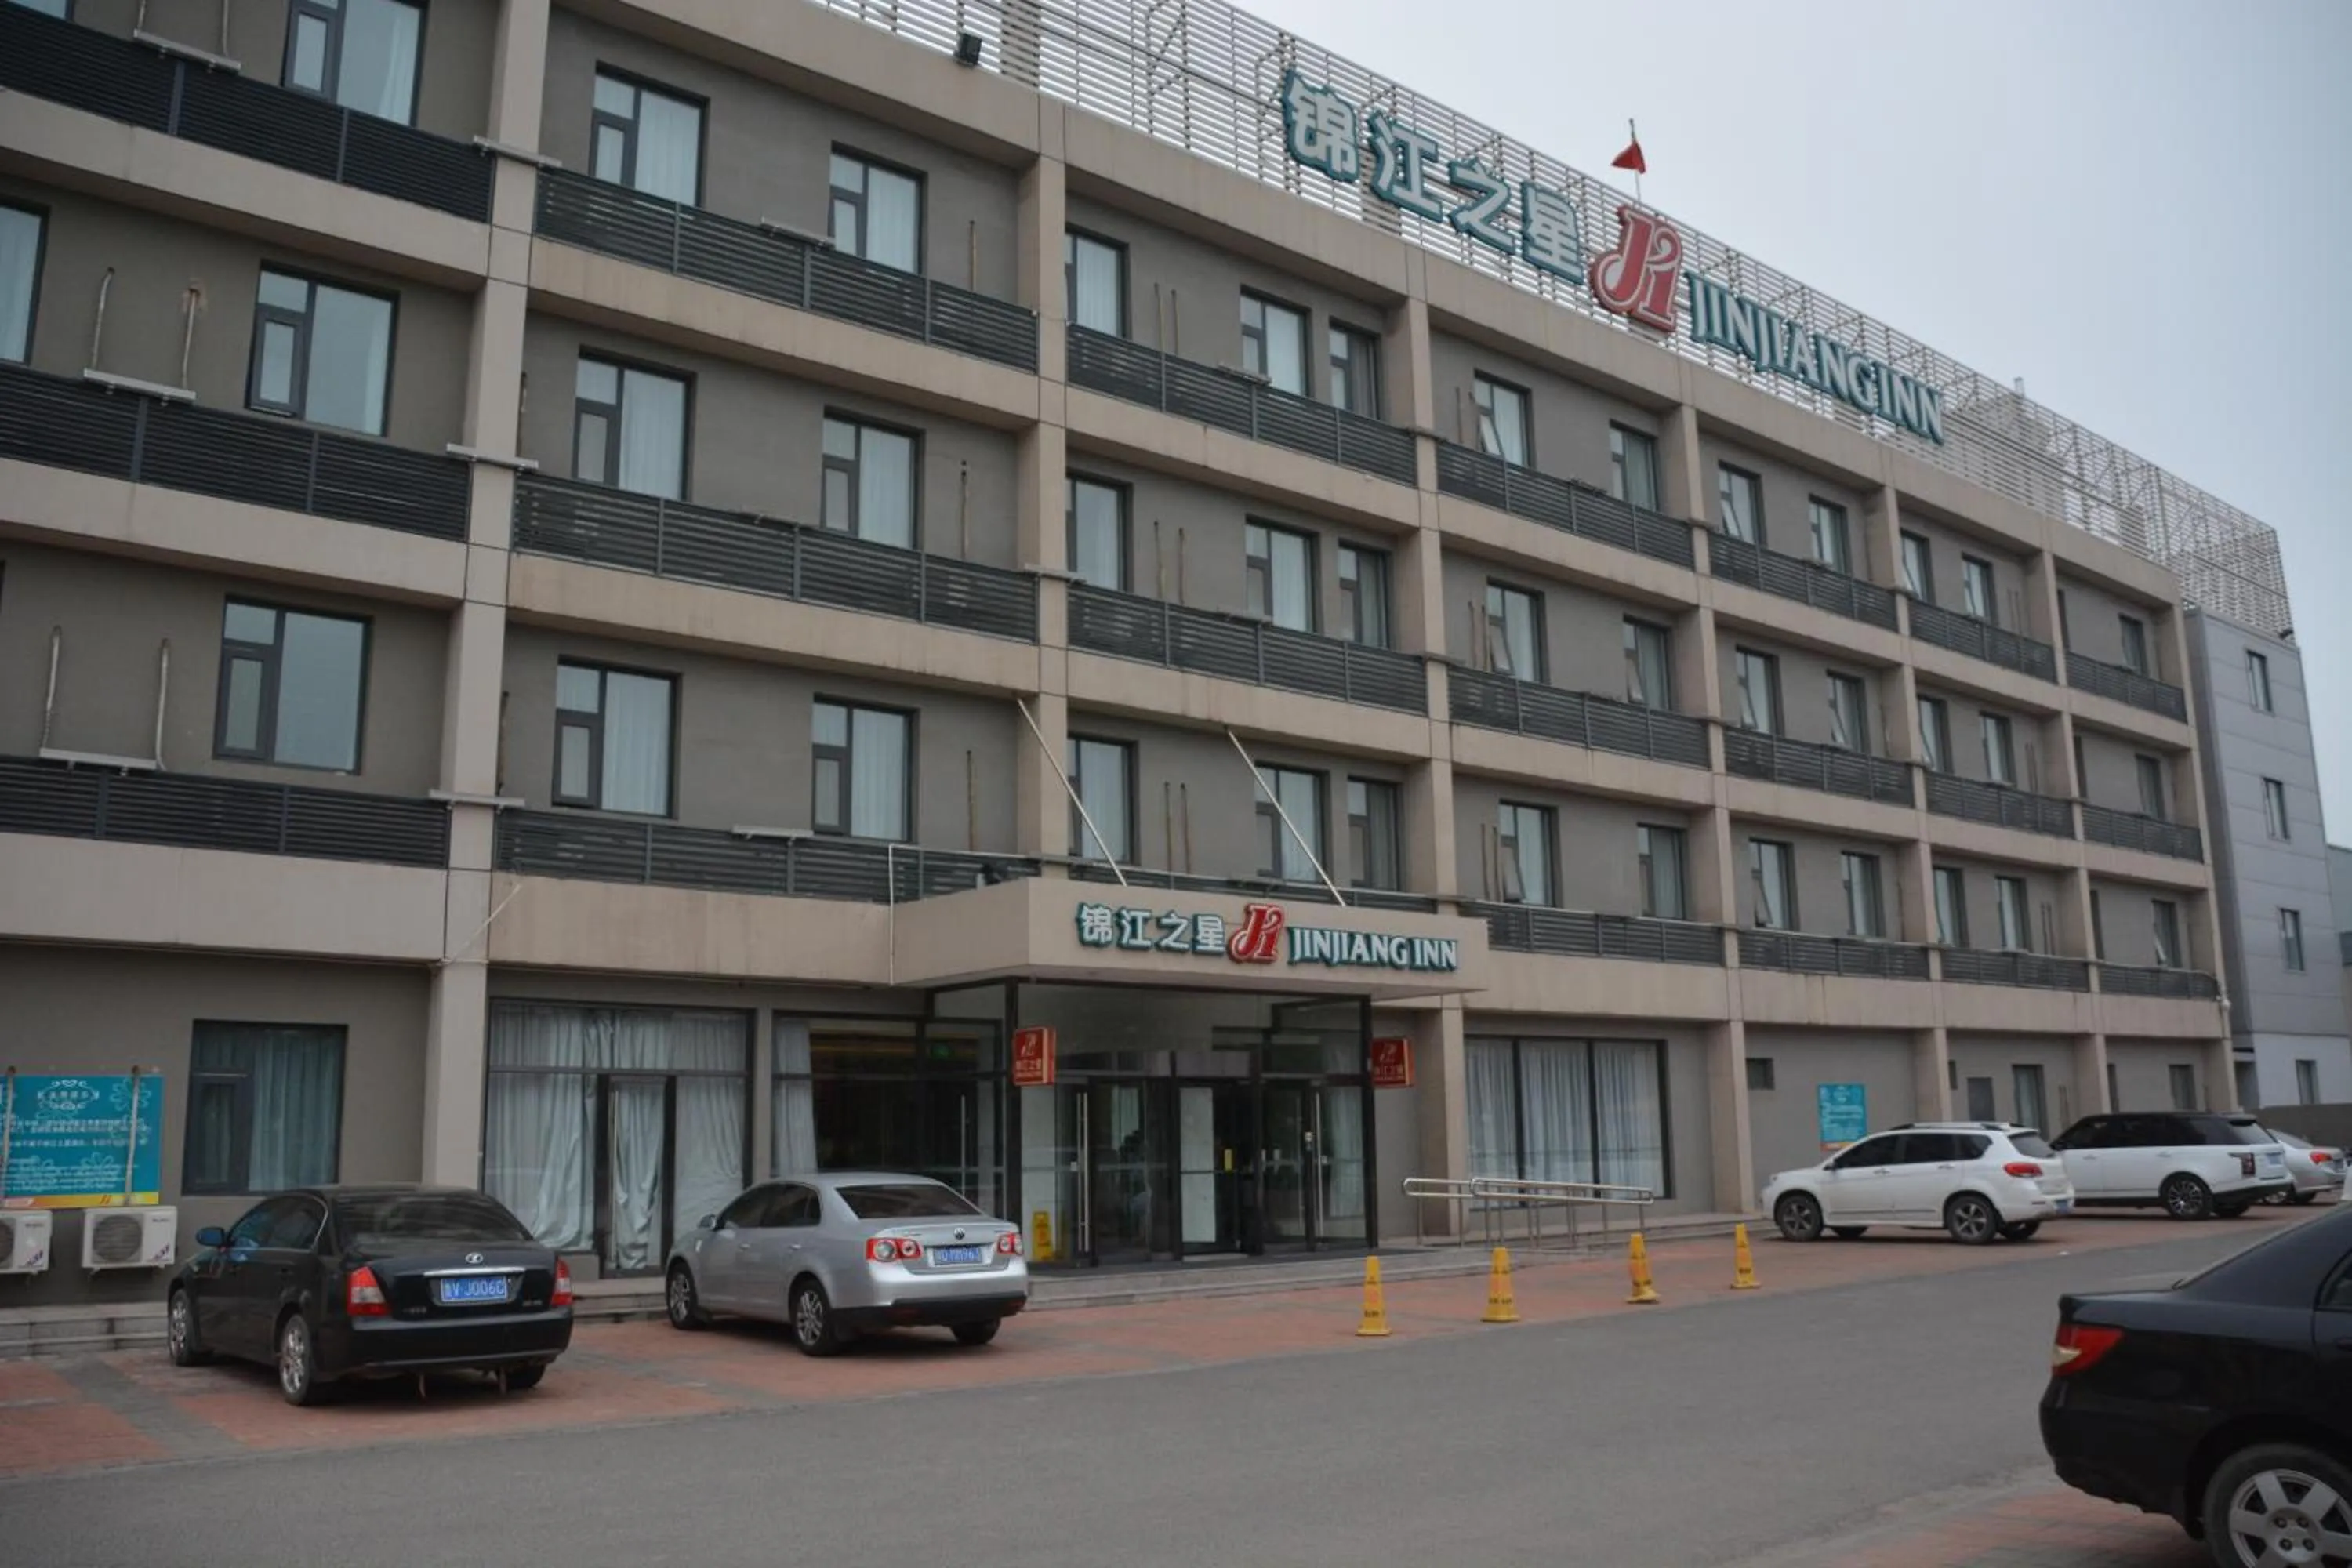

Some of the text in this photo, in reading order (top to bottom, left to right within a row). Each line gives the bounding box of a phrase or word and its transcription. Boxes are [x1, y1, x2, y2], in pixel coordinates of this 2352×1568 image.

[1283, 68, 1584, 285] 锦江之星
[1686, 271, 1944, 445] JINJIANG INN
[1076, 902, 1225, 956] 锦江之星
[1287, 926, 1458, 971] JINJIANG INN
